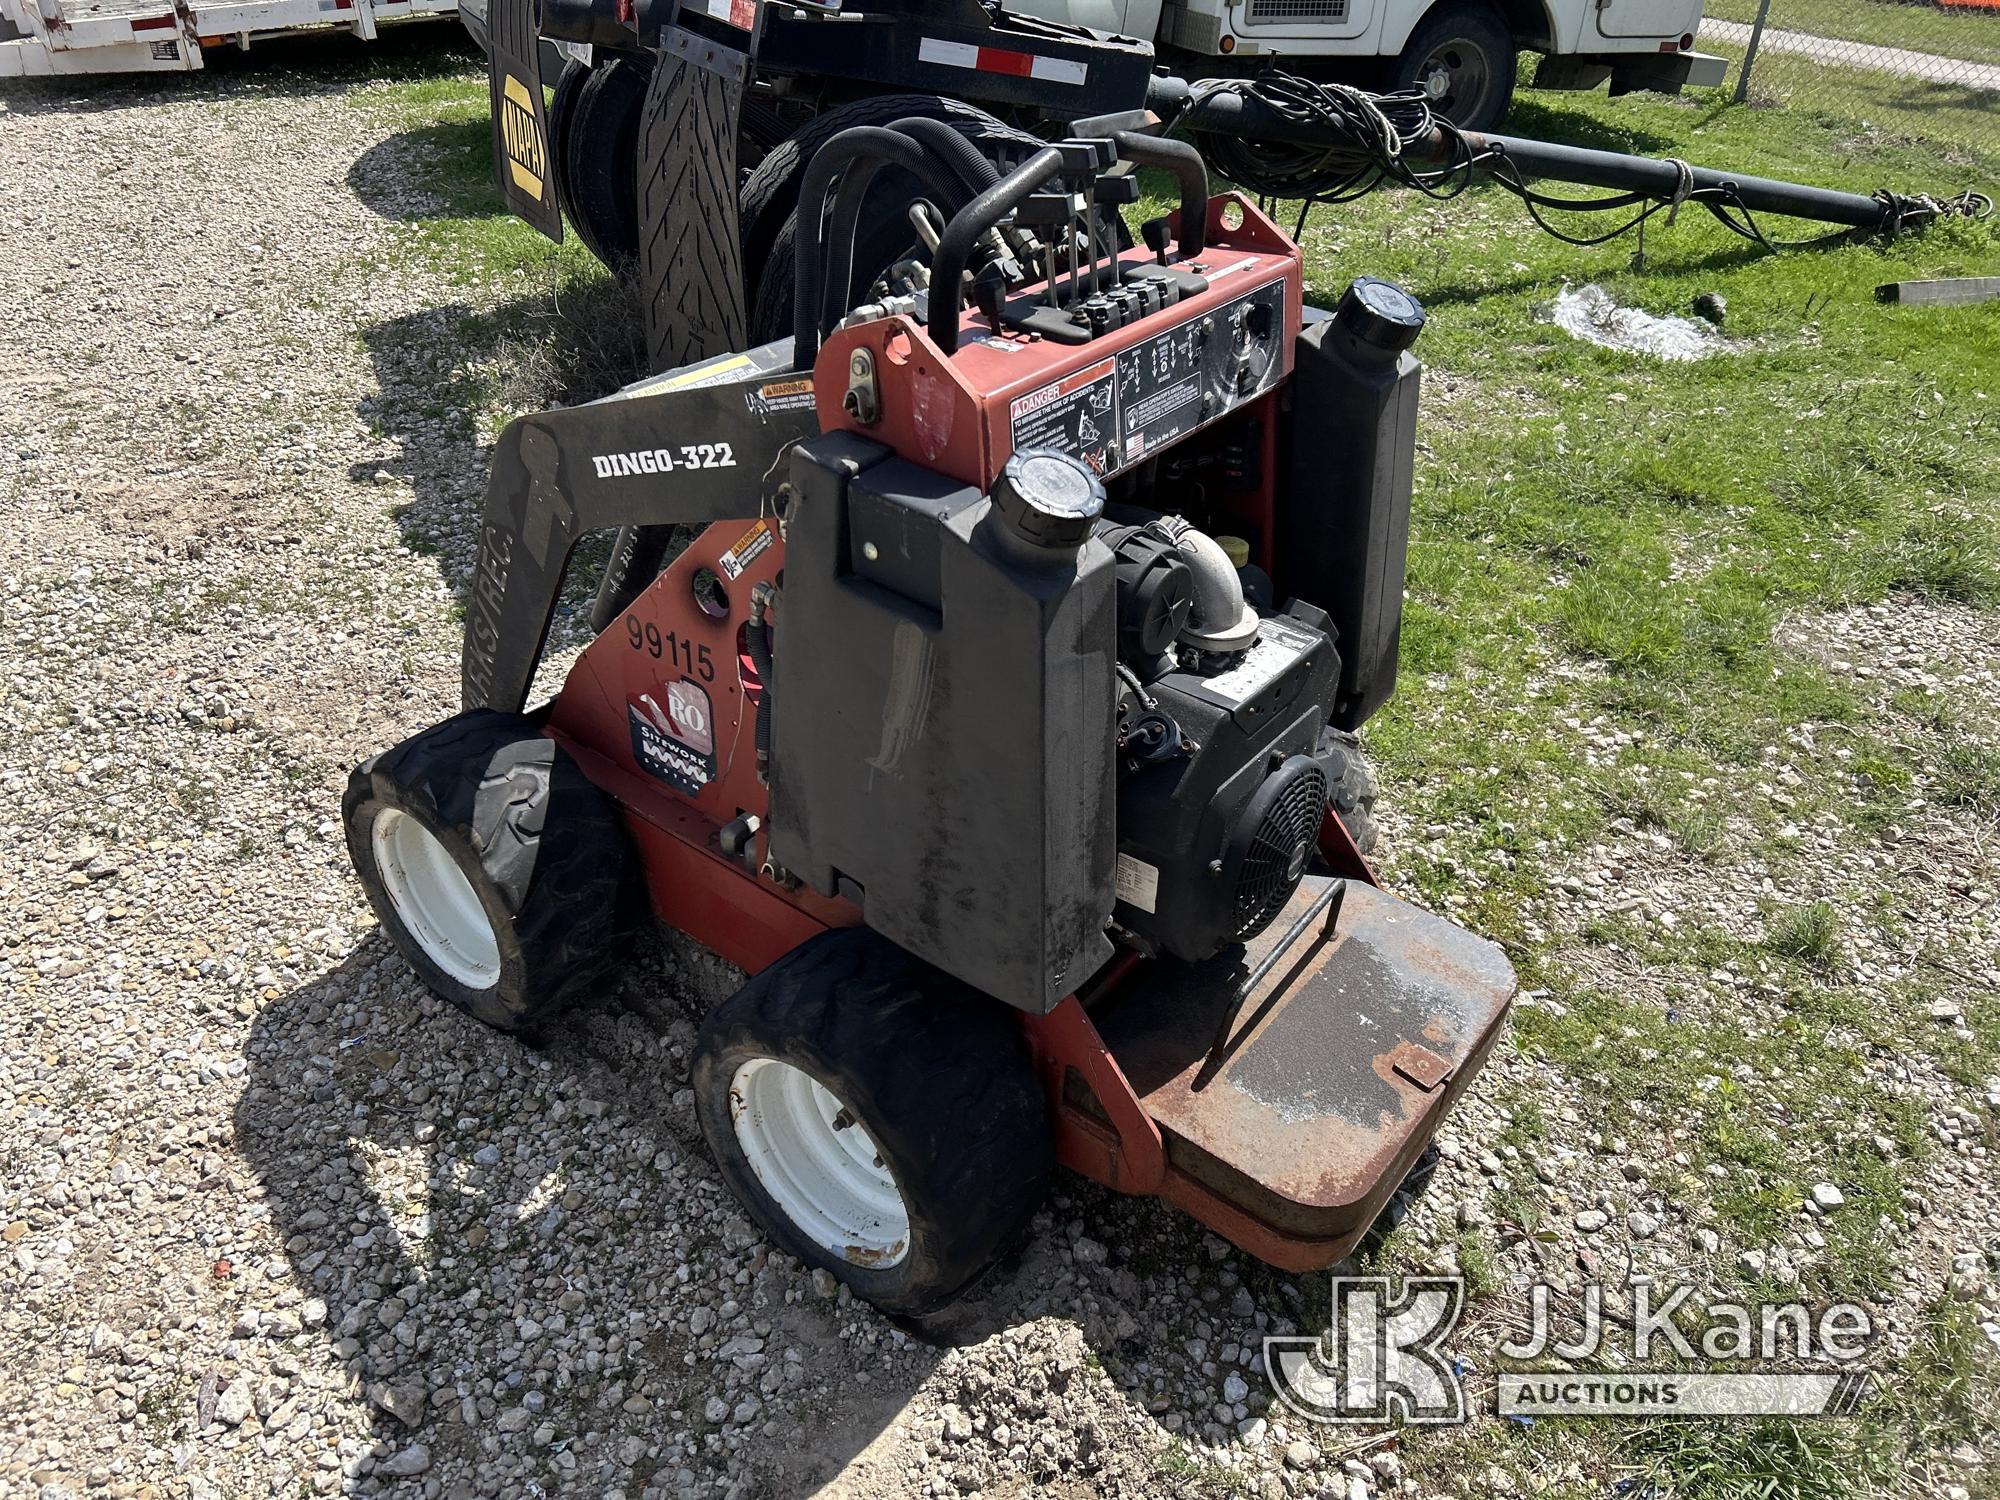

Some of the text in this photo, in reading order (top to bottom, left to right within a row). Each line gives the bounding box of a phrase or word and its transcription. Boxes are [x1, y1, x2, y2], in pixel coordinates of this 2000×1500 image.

[506, 99, 542, 178] NAPA
[772, 382, 807, 394] WARNING
[1022, 386, 1060, 413] DANGER
[1145, 439, 1157, 450] Made
[1169, 426, 1179, 437] USA
[592, 442, 737, 478] DINGO-322
[738, 526, 760, 550] WARNING
[625, 613, 715, 682] 99115
[641, 726, 706, 768] SITEWORK
